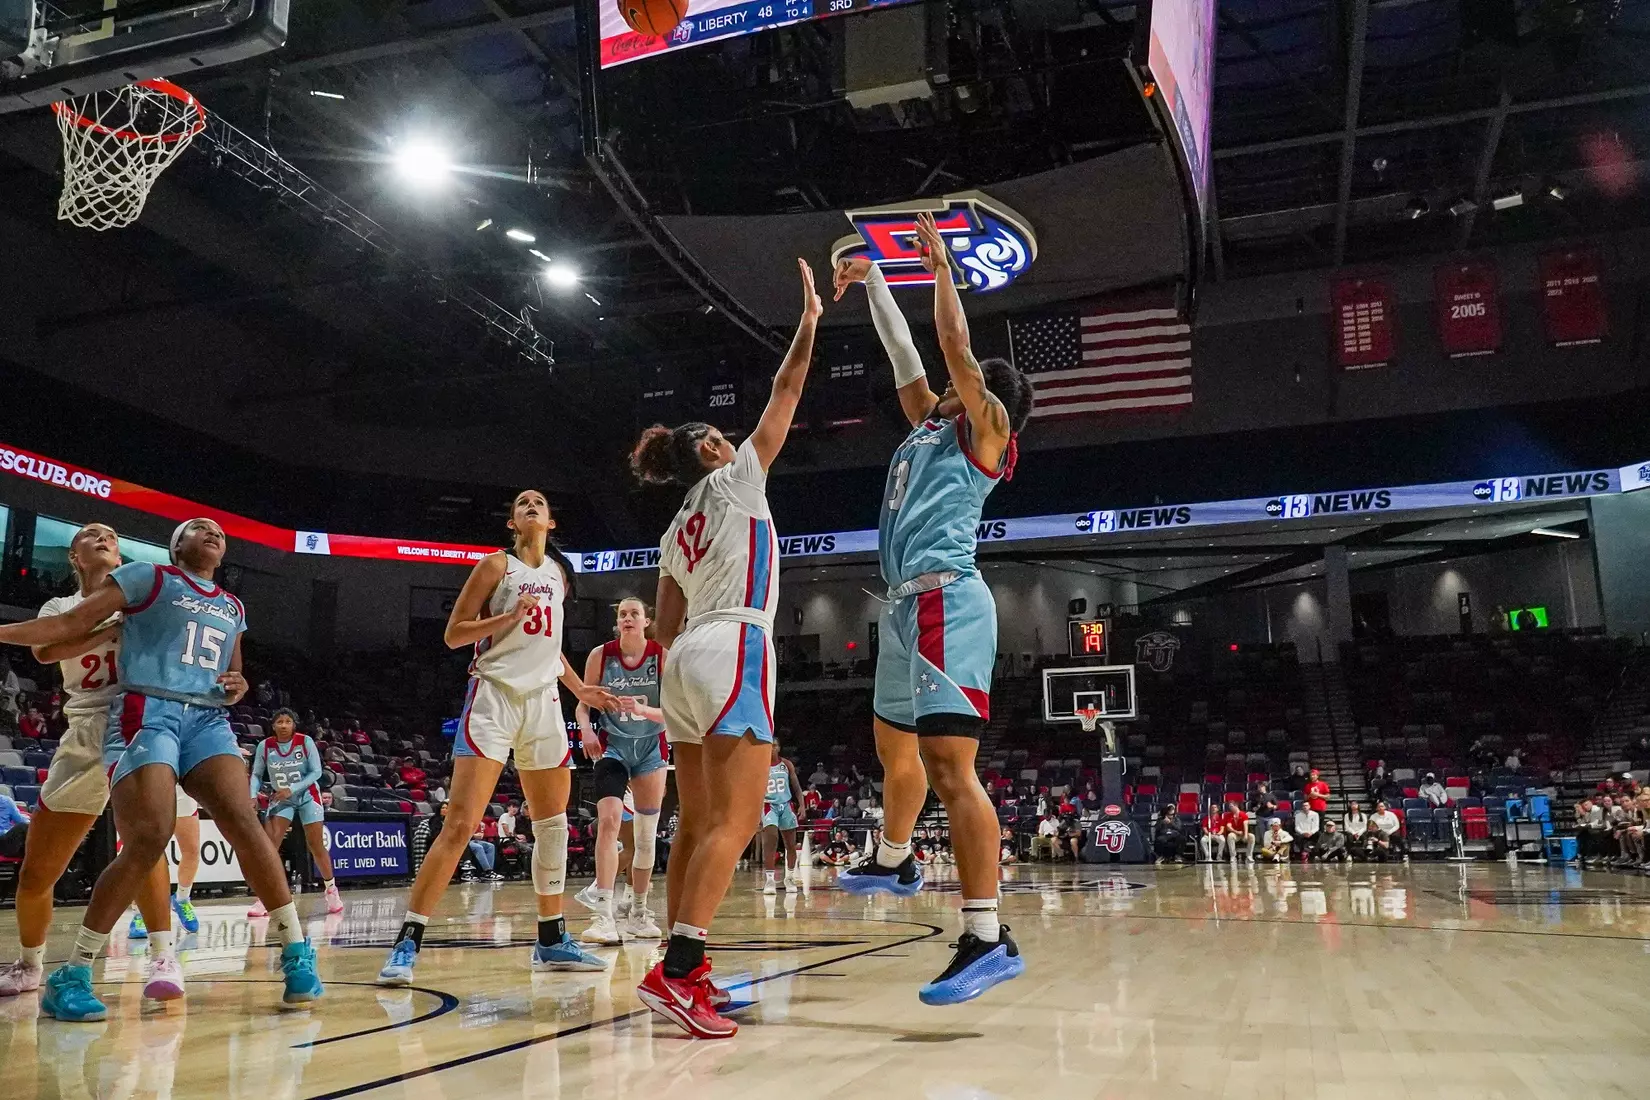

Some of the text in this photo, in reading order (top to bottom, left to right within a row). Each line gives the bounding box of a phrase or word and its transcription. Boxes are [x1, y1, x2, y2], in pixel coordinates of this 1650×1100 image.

[757, 5, 773, 18] 48
[786, 6, 808, 17] TO 4
[829, 0, 853, 12] 3RD
[698, 11, 748, 32] LIBERTY
[1450, 303, 1486, 319] 2005
[709, 393, 736, 407] 2023
[1473, 472, 1610, 502] abc 13 NEWS
[1283, 495, 1308, 518] 13
[1313, 490, 1391, 513] NEWS
[1091, 511, 1115, 533] 13
[1119, 507, 1191, 529] NEWS
[677, 511, 714, 574] 12
[778, 535, 836, 555] NEWS
[397, 546, 430, 556] WELCOME
[440, 549, 466, 559] LIBERTY
[595, 551, 615, 571] 13
[618, 549, 661, 567] NEW
[517, 582, 554, 601] Liberty
[523, 605, 552, 637] 31
[1080, 623, 1103, 634] 7:30
[181, 620, 228, 671] 15
[1085, 634, 1101, 652] 19
[80, 650, 119, 689] 21
[767, 777, 786, 794] 22
[334, 829, 407, 849] Carter Bank
[333, 856, 399, 869] LIFE LIVED FULL
